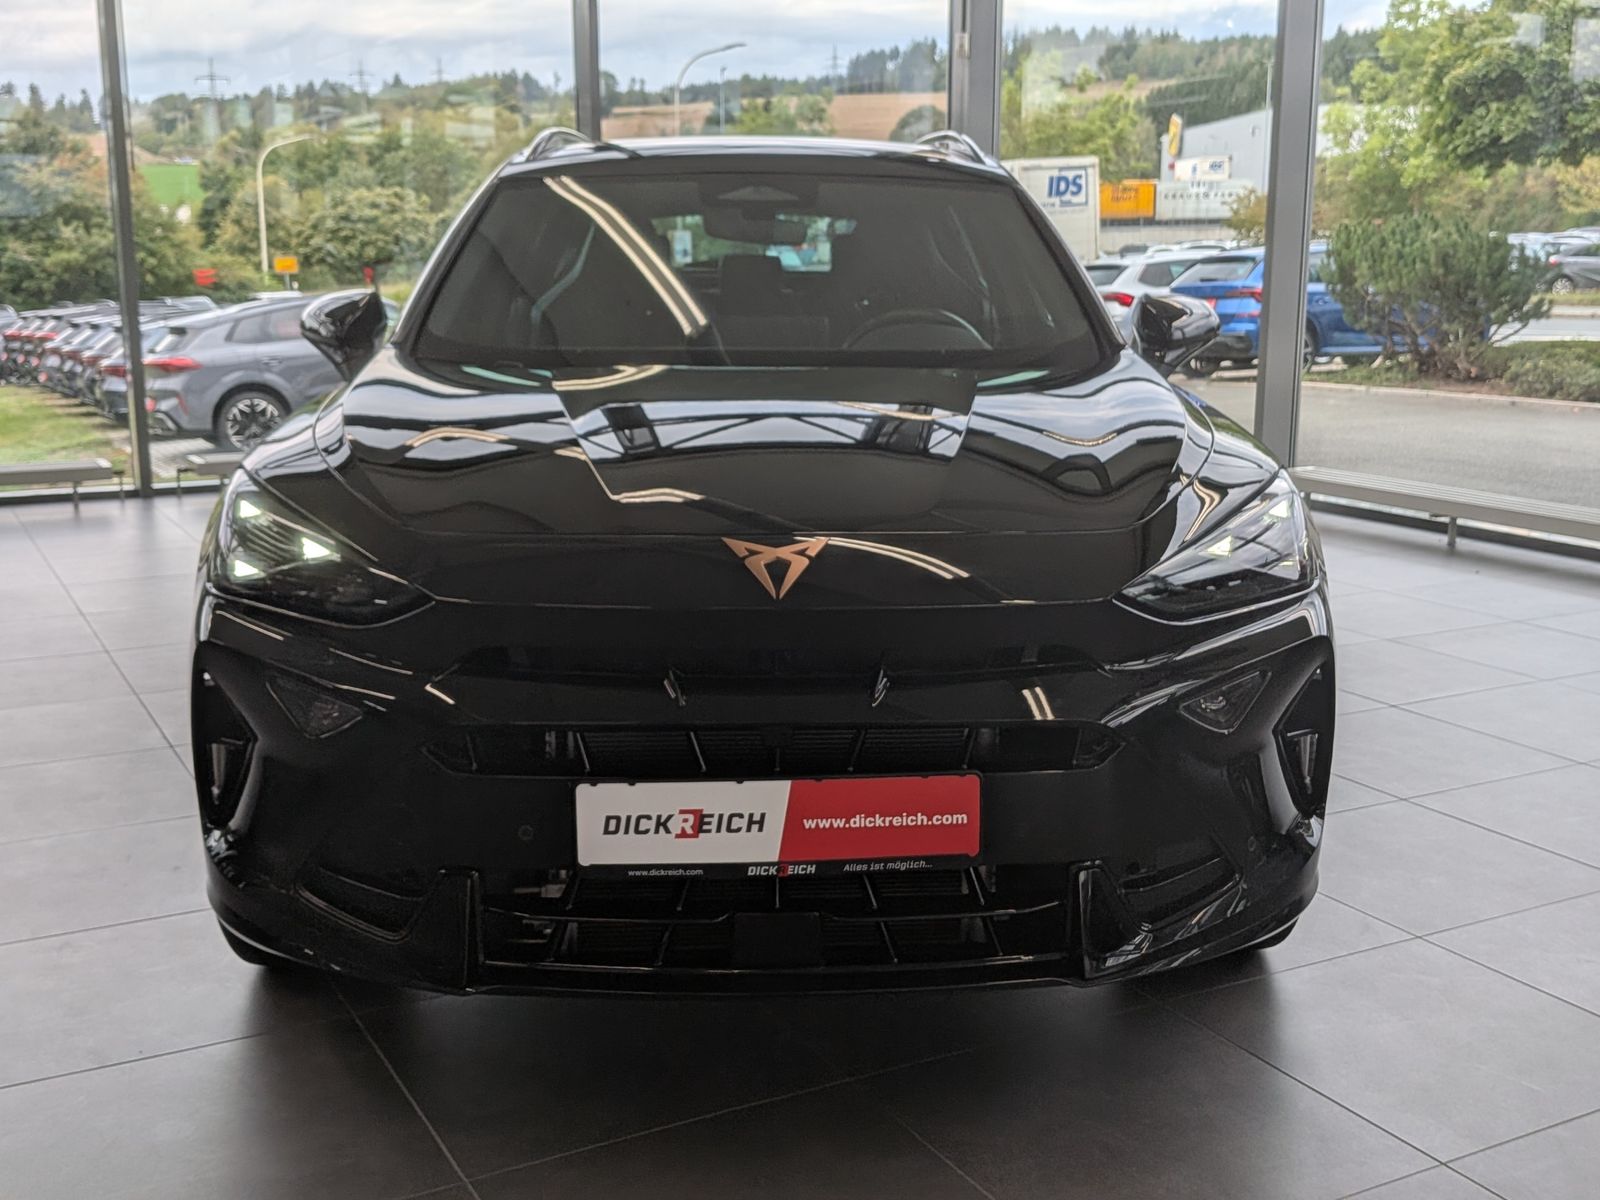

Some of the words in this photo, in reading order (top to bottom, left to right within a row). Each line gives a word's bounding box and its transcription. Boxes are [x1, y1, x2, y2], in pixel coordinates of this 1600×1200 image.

[1047, 174, 1083, 198] IDS
[602, 810, 767, 838] DICKREICH
[803, 812, 968, 829] www.dickreich.com
[628, 868, 704, 876] www.dickreich.com
[843, 863, 868, 872] Alles
[870, 862, 885, 871] ist
